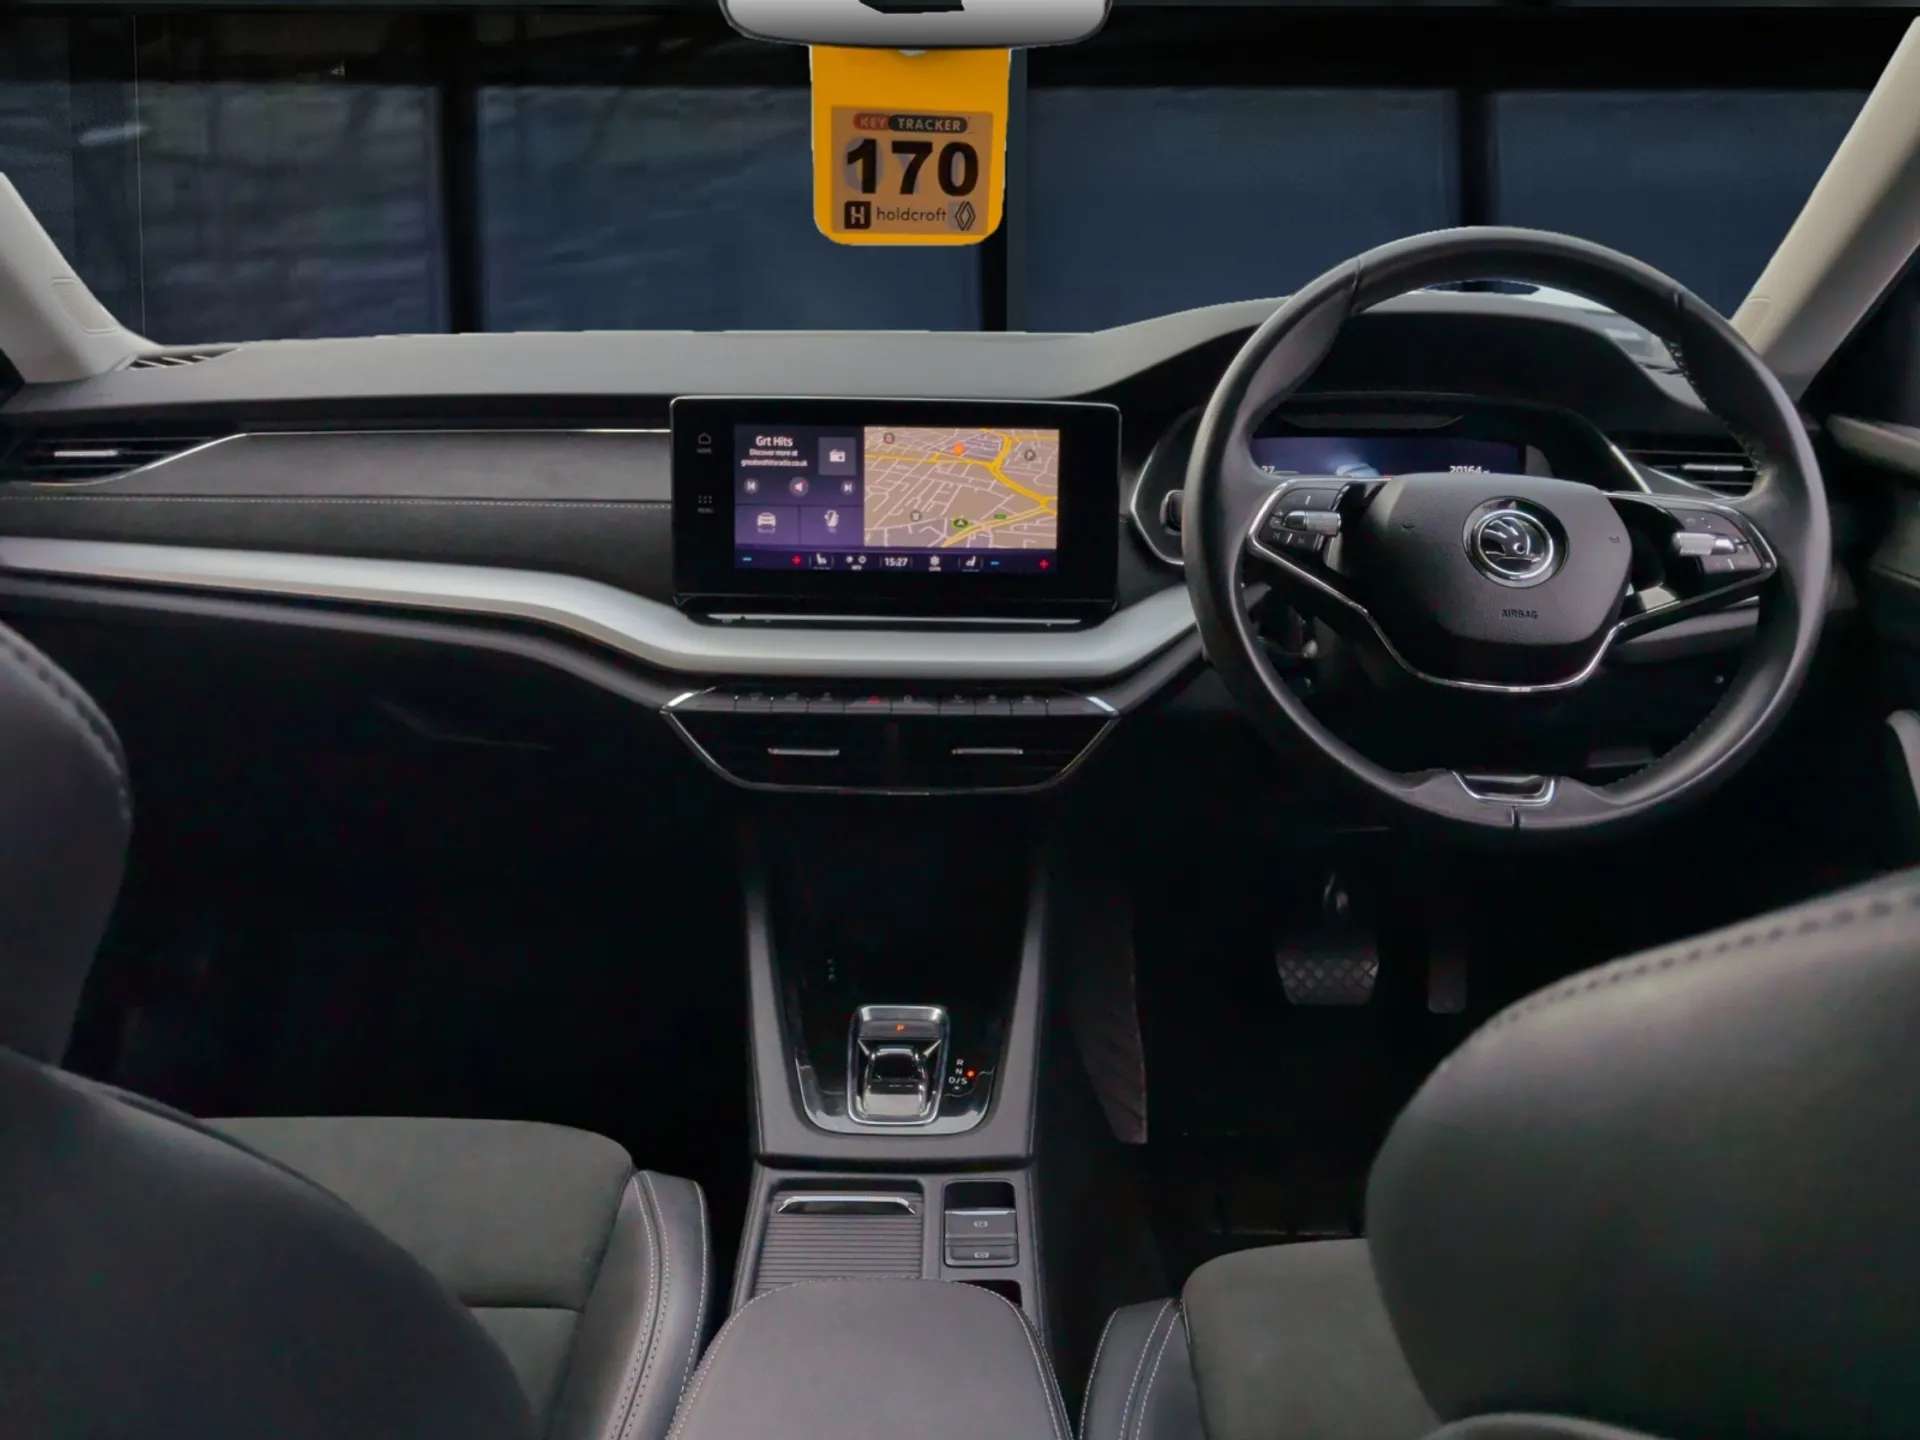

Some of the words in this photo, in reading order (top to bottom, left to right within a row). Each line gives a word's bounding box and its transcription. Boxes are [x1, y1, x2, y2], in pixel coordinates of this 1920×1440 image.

[859, 117, 887, 128] KEY
[897, 117, 961, 131] TRACKER
[847, 138, 979, 197] 170
[876, 206, 946, 222] holdcroft
[756, 435, 771, 447] Grt
[773, 435, 793, 447] Hits
[884, 557, 908, 568] 15:27
[1502, 608, 1539, 620] AIRBAG
[956, 1058, 964, 1066] R
